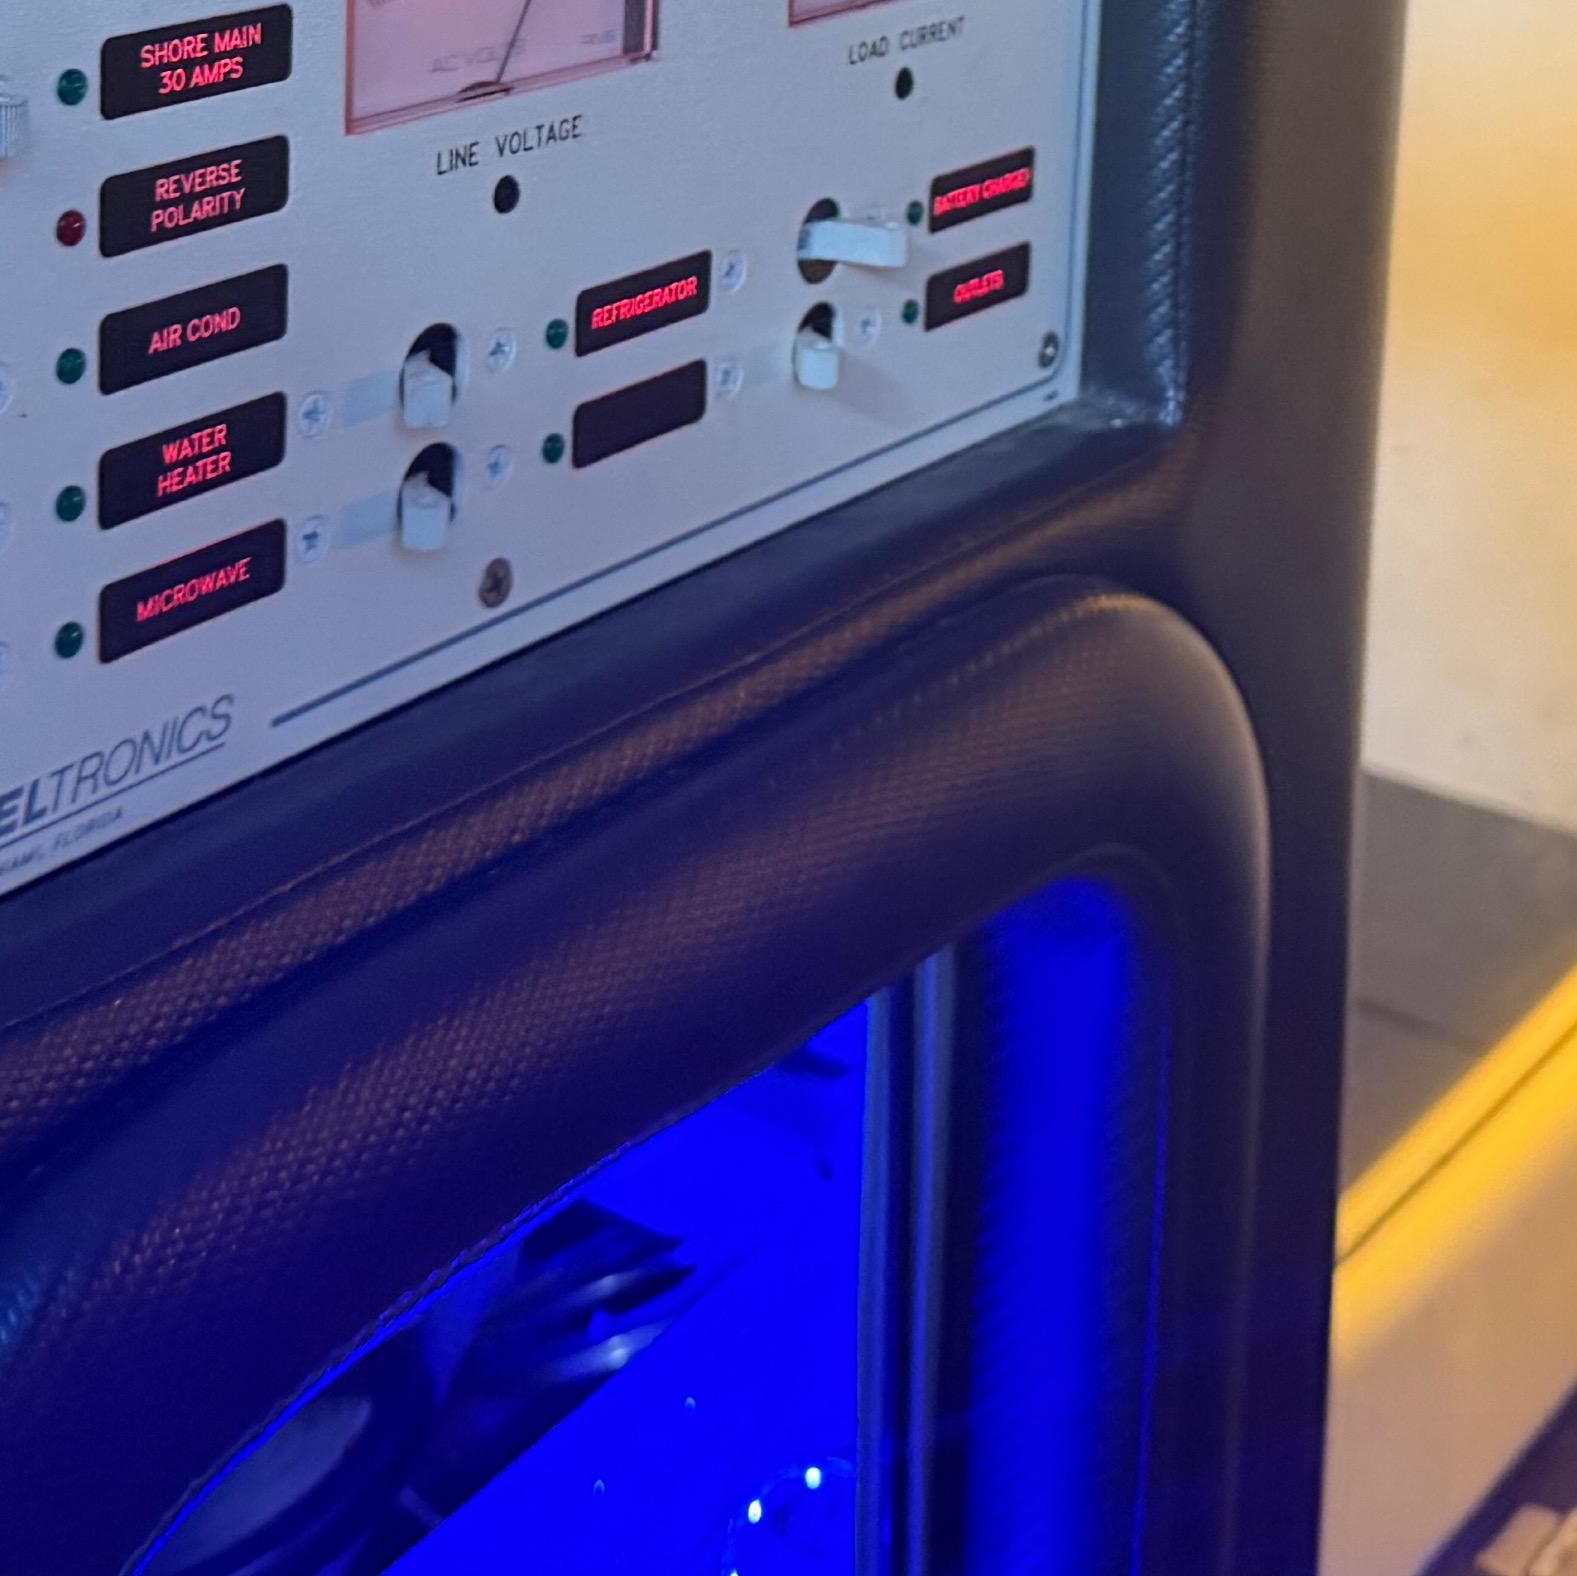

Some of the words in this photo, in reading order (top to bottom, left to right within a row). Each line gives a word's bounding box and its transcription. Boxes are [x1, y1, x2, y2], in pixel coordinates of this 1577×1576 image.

[140, 32, 210, 71] SHORE
[213, 24, 263, 53] MAIN
[848, 36, 889, 65] LOAD
[899, 16, 965, 51] CURRENT
[159, 68, 185, 94] 30
[188, 56, 244, 89] AMPS
[436, 142, 480, 176] LINE
[495, 114, 584, 160] VOLTAGE
[155, 160, 243, 202] REVERSE
[151, 189, 246, 233] POLARITY
[591, 275, 698, 331] REFRIGERATOR
[149, 325, 182, 354] AIR
[185, 307, 241, 346] COND
[162, 424, 228, 464] WATER
[157, 450, 232, 498] HEATER
[136, 557, 251, 621] MICROWAVE
